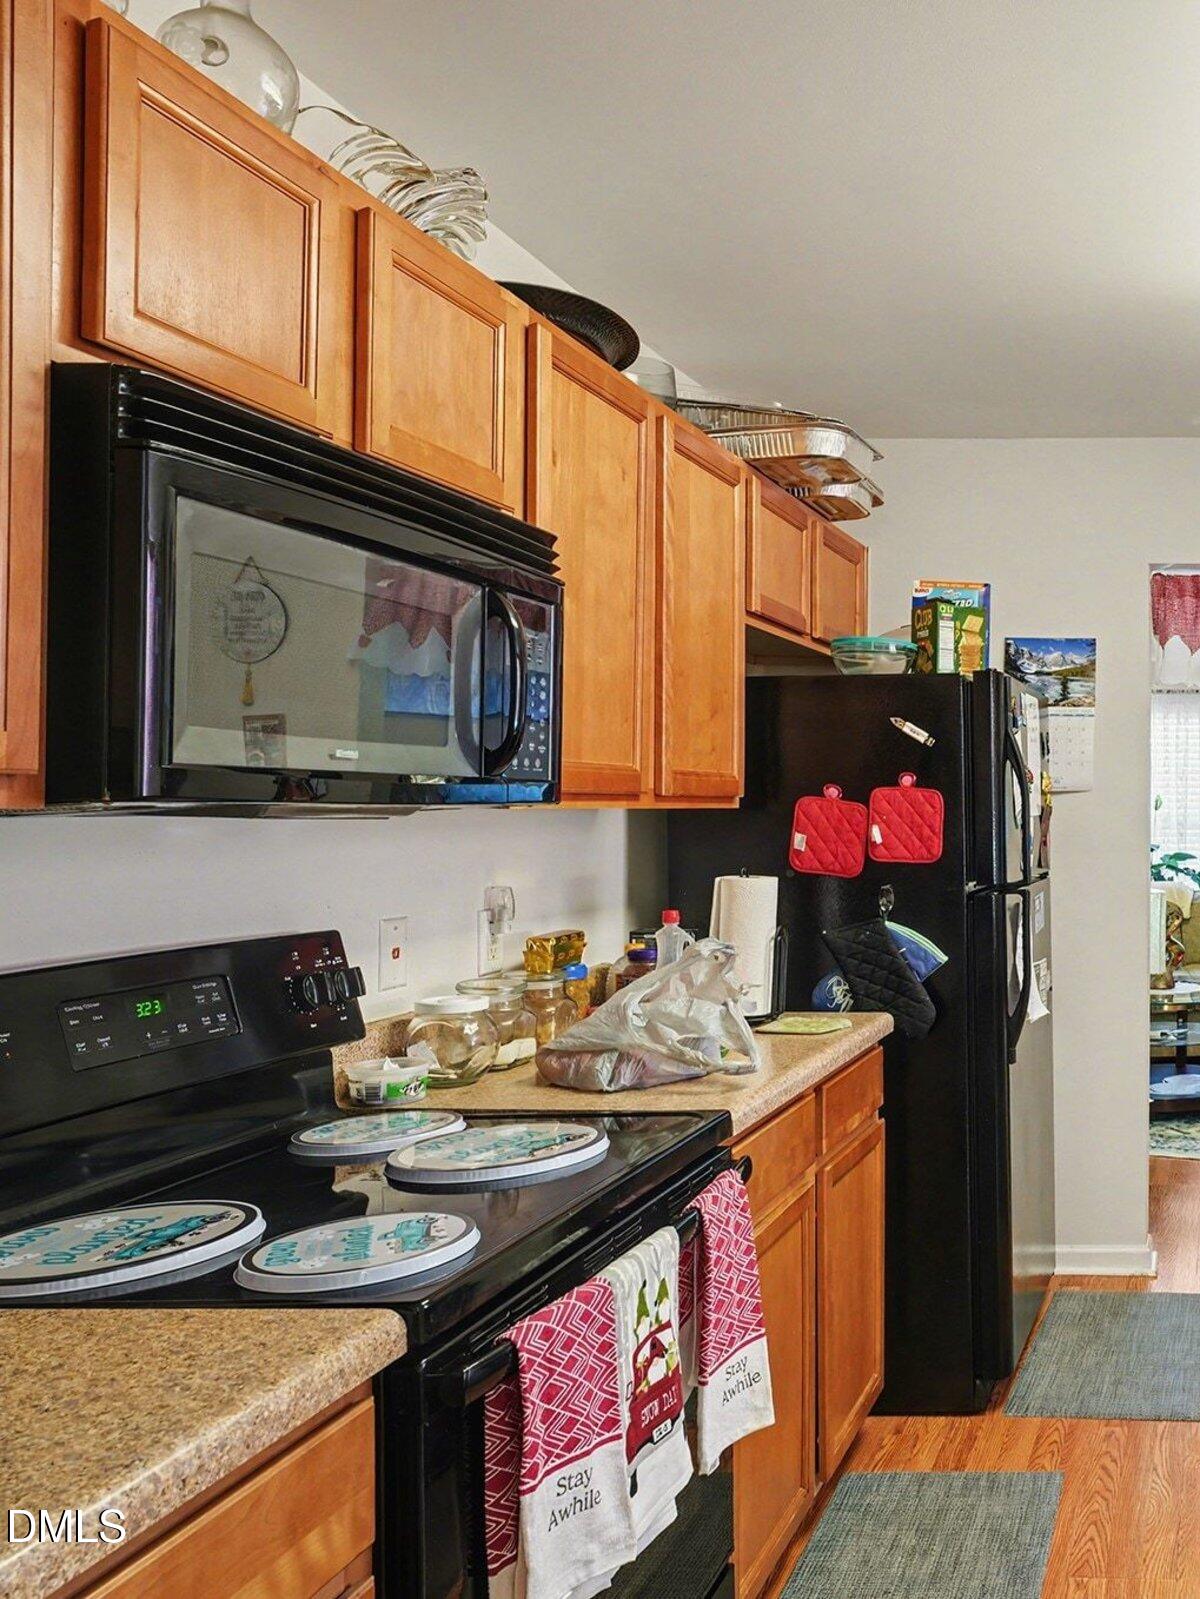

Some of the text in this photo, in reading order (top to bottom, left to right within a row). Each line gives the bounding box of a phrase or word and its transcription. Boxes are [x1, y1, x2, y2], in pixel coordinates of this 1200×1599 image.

[724, 1355, 748, 1382] Stay
[721, 1370, 762, 1407] Awhile
[556, 1466, 594, 1497] Stay
[548, 1488, 602, 1532] Awhile
